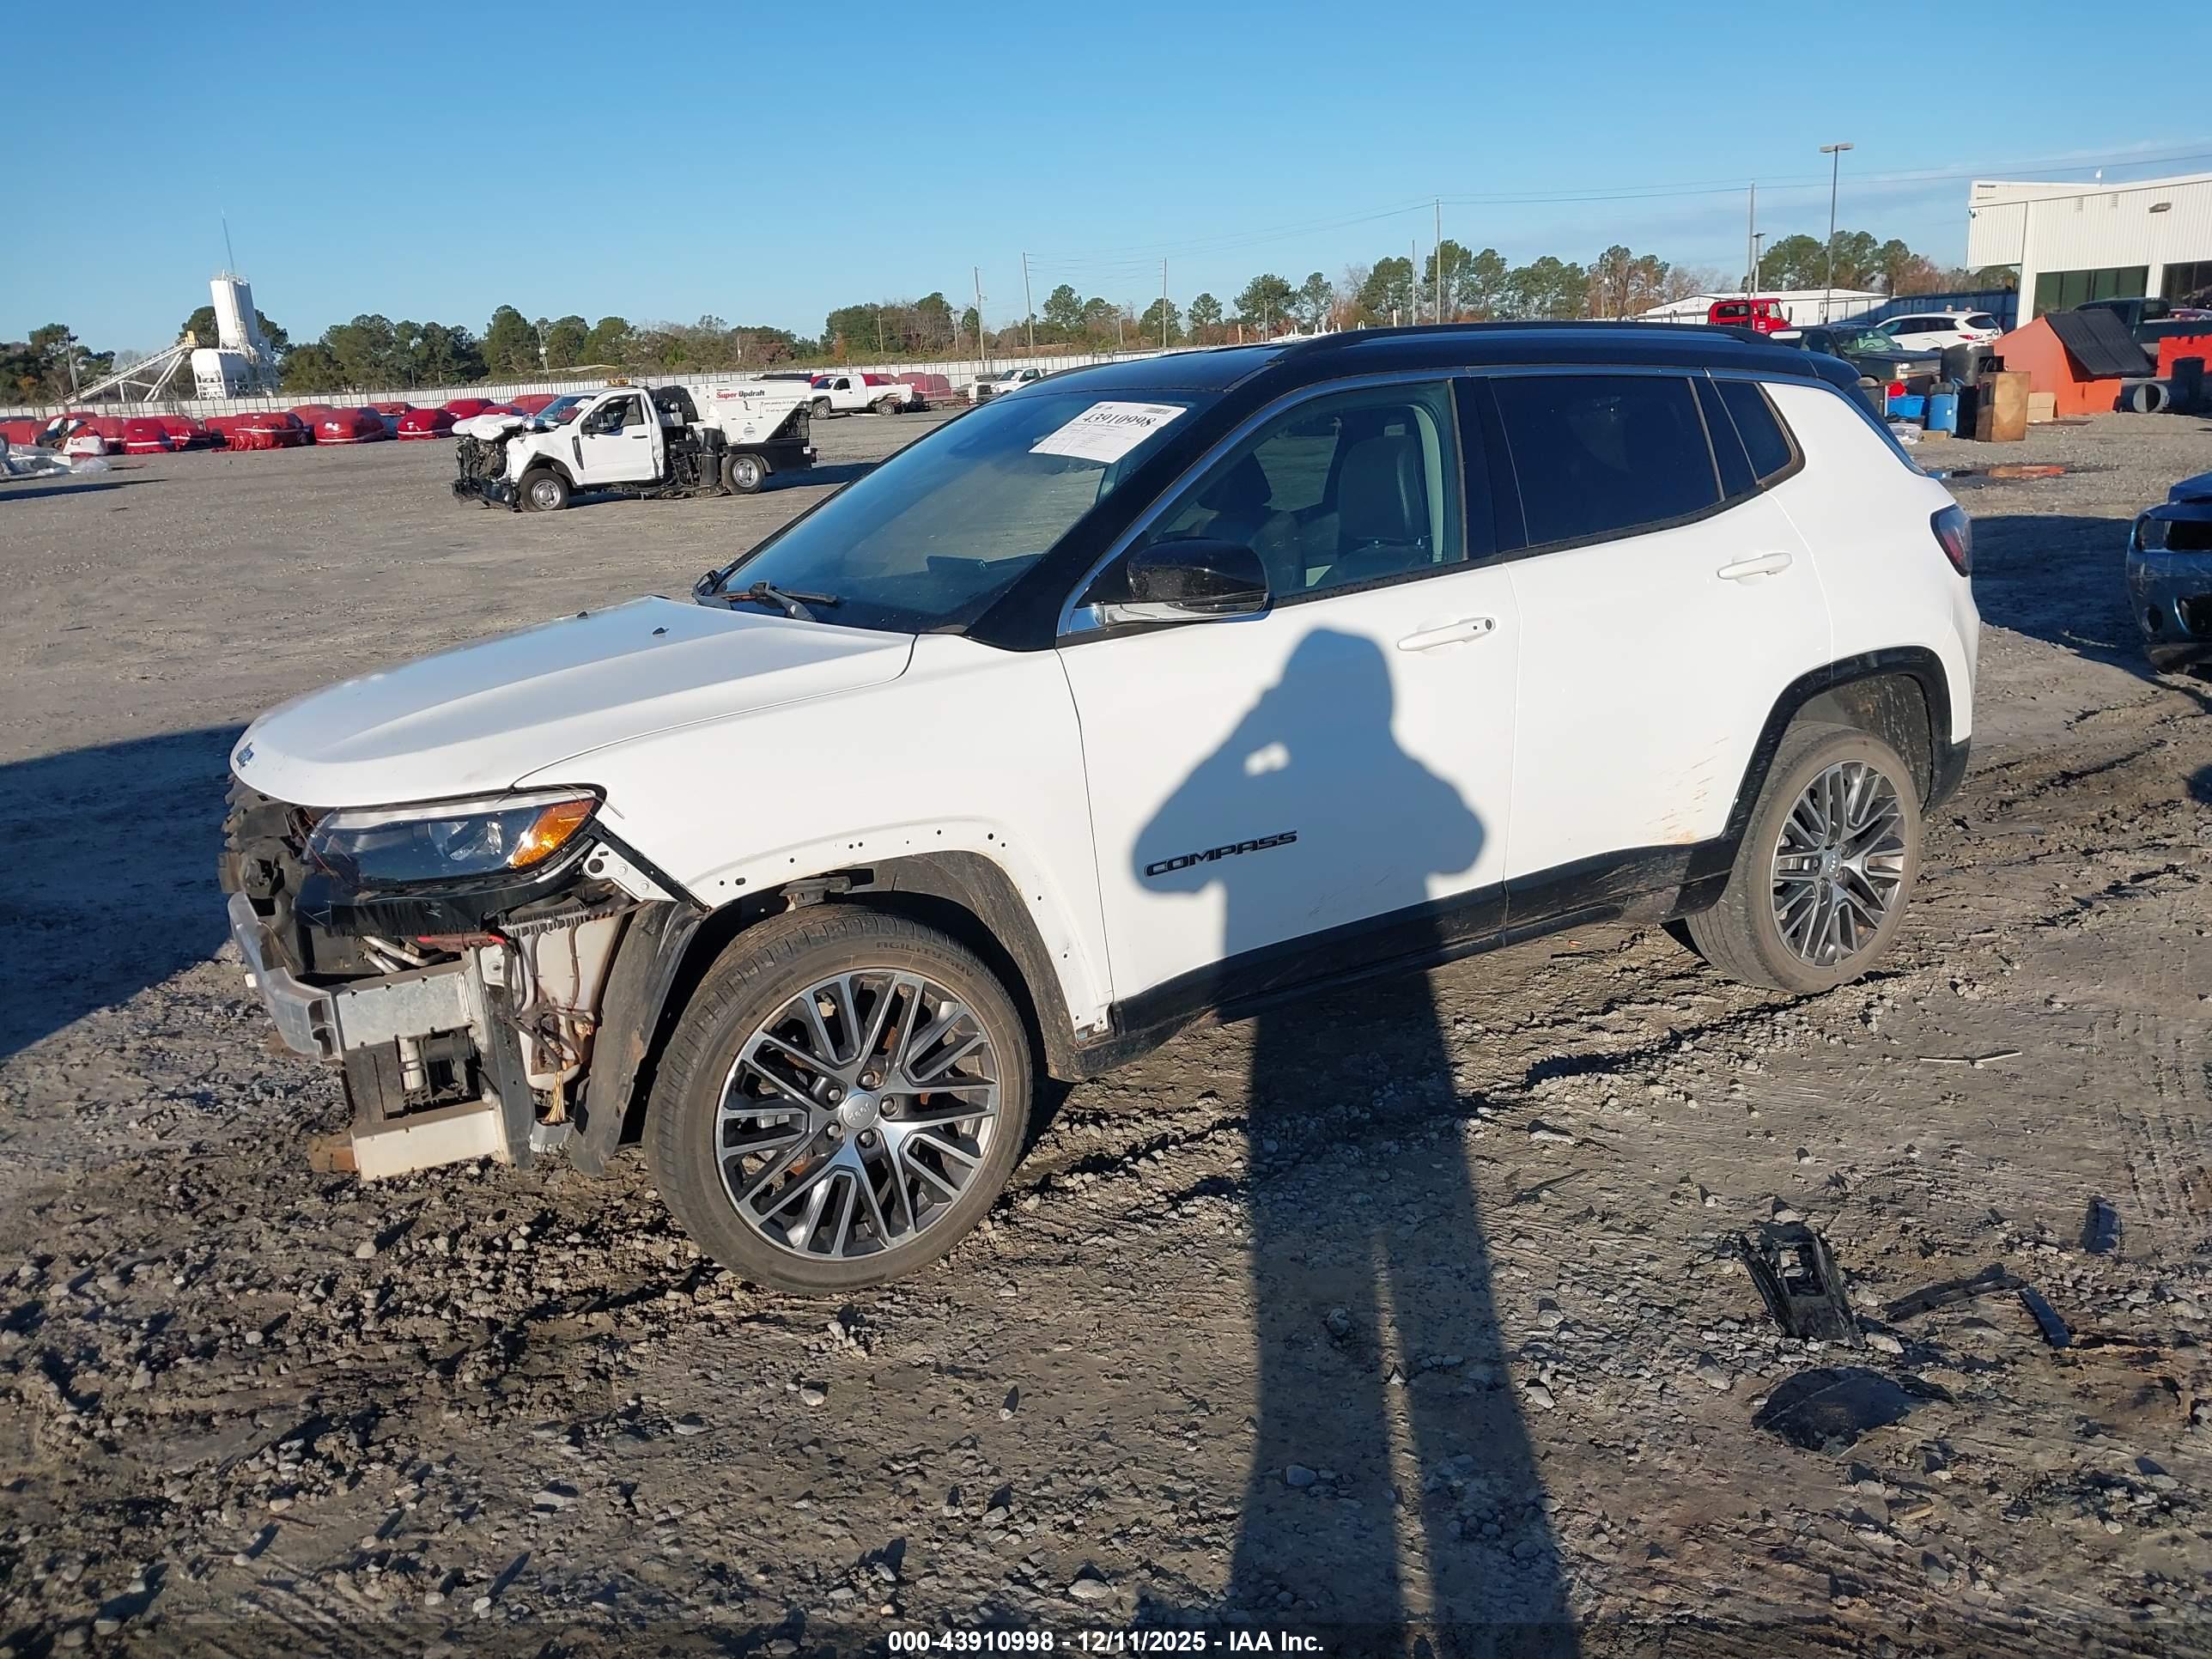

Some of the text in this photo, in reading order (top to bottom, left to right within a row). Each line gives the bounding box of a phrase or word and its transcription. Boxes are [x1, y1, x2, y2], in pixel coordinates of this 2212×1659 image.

[716, 389, 765, 400] Super Updraft
[1082, 412, 1158, 428] 43910998
[1144, 830, 1298, 878] COMPASS
